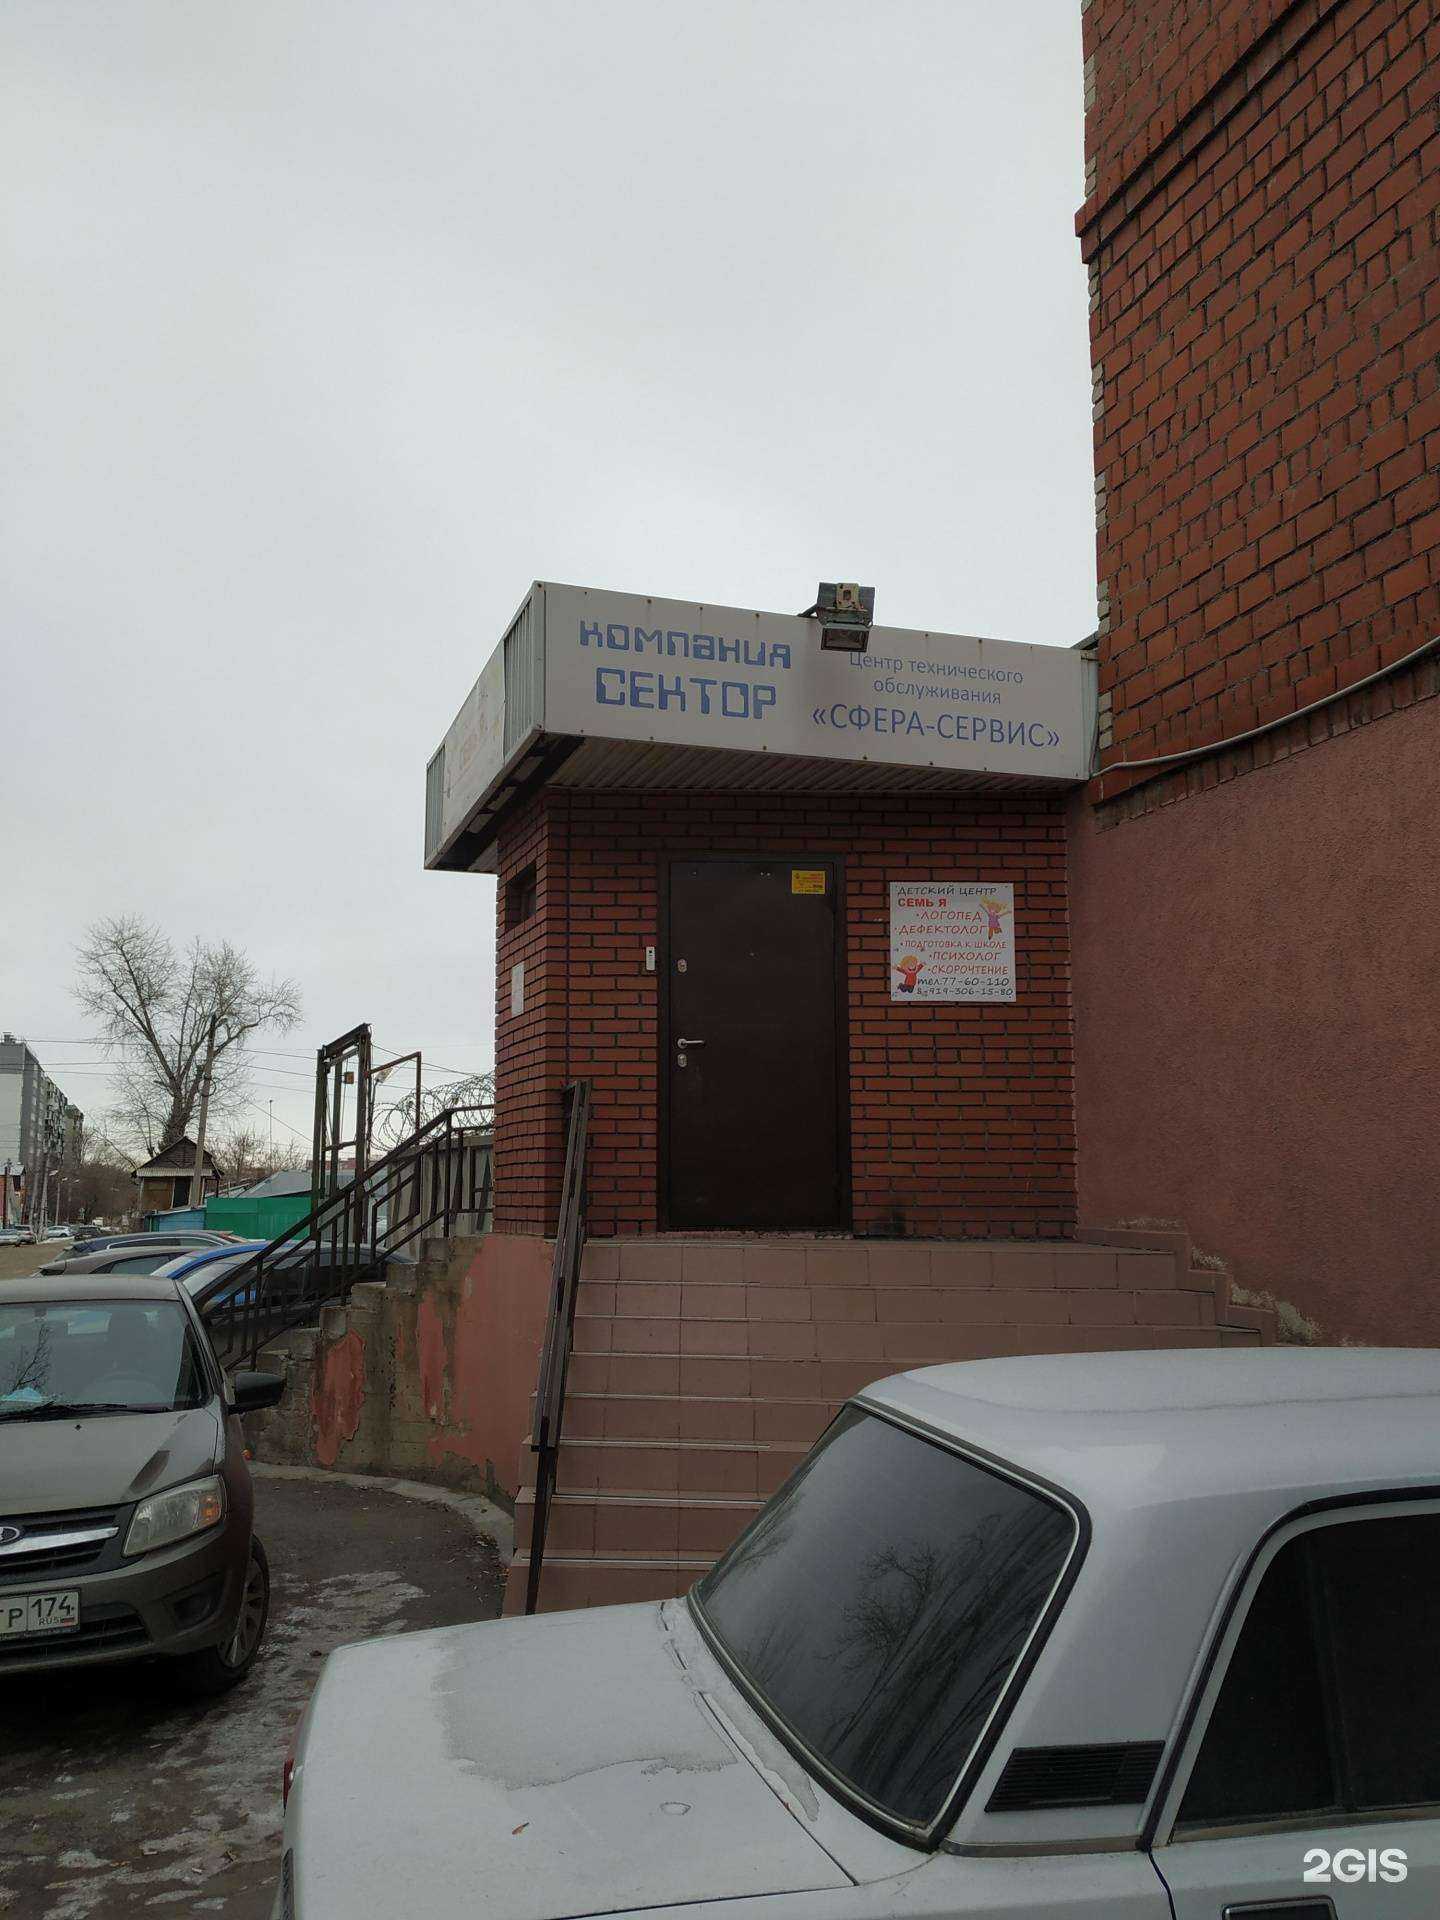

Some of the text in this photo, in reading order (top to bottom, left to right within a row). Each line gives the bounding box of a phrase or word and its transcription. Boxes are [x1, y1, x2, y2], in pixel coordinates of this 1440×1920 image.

[849, 652, 1024, 684] Центр технического
[596, 667, 776, 720] СЕКТОР
[873, 677, 1001, 704] обслуживания
[812, 702, 1060, 748] «СФЕРА-СЕРВИС»
[897, 885, 997, 897] ДЕТСКИЙ ЦЕНТР
[898, 898, 947, 908] СЕМЬ Я
[920, 911, 982, 922] ЛОГОПЕД
[899, 924, 988, 936] ДЕФЕКТОЛОГ
[905, 940, 964, 950] ПОДГОТОВКА
[974, 940, 1008, 949] ШКОЛЕ
[933, 952, 1001, 961] ПСИХОЛОГ
[931, 964, 1009, 975] СКОРОЧТЕНИЕ
[30, 1595, 71, 1618] 174
